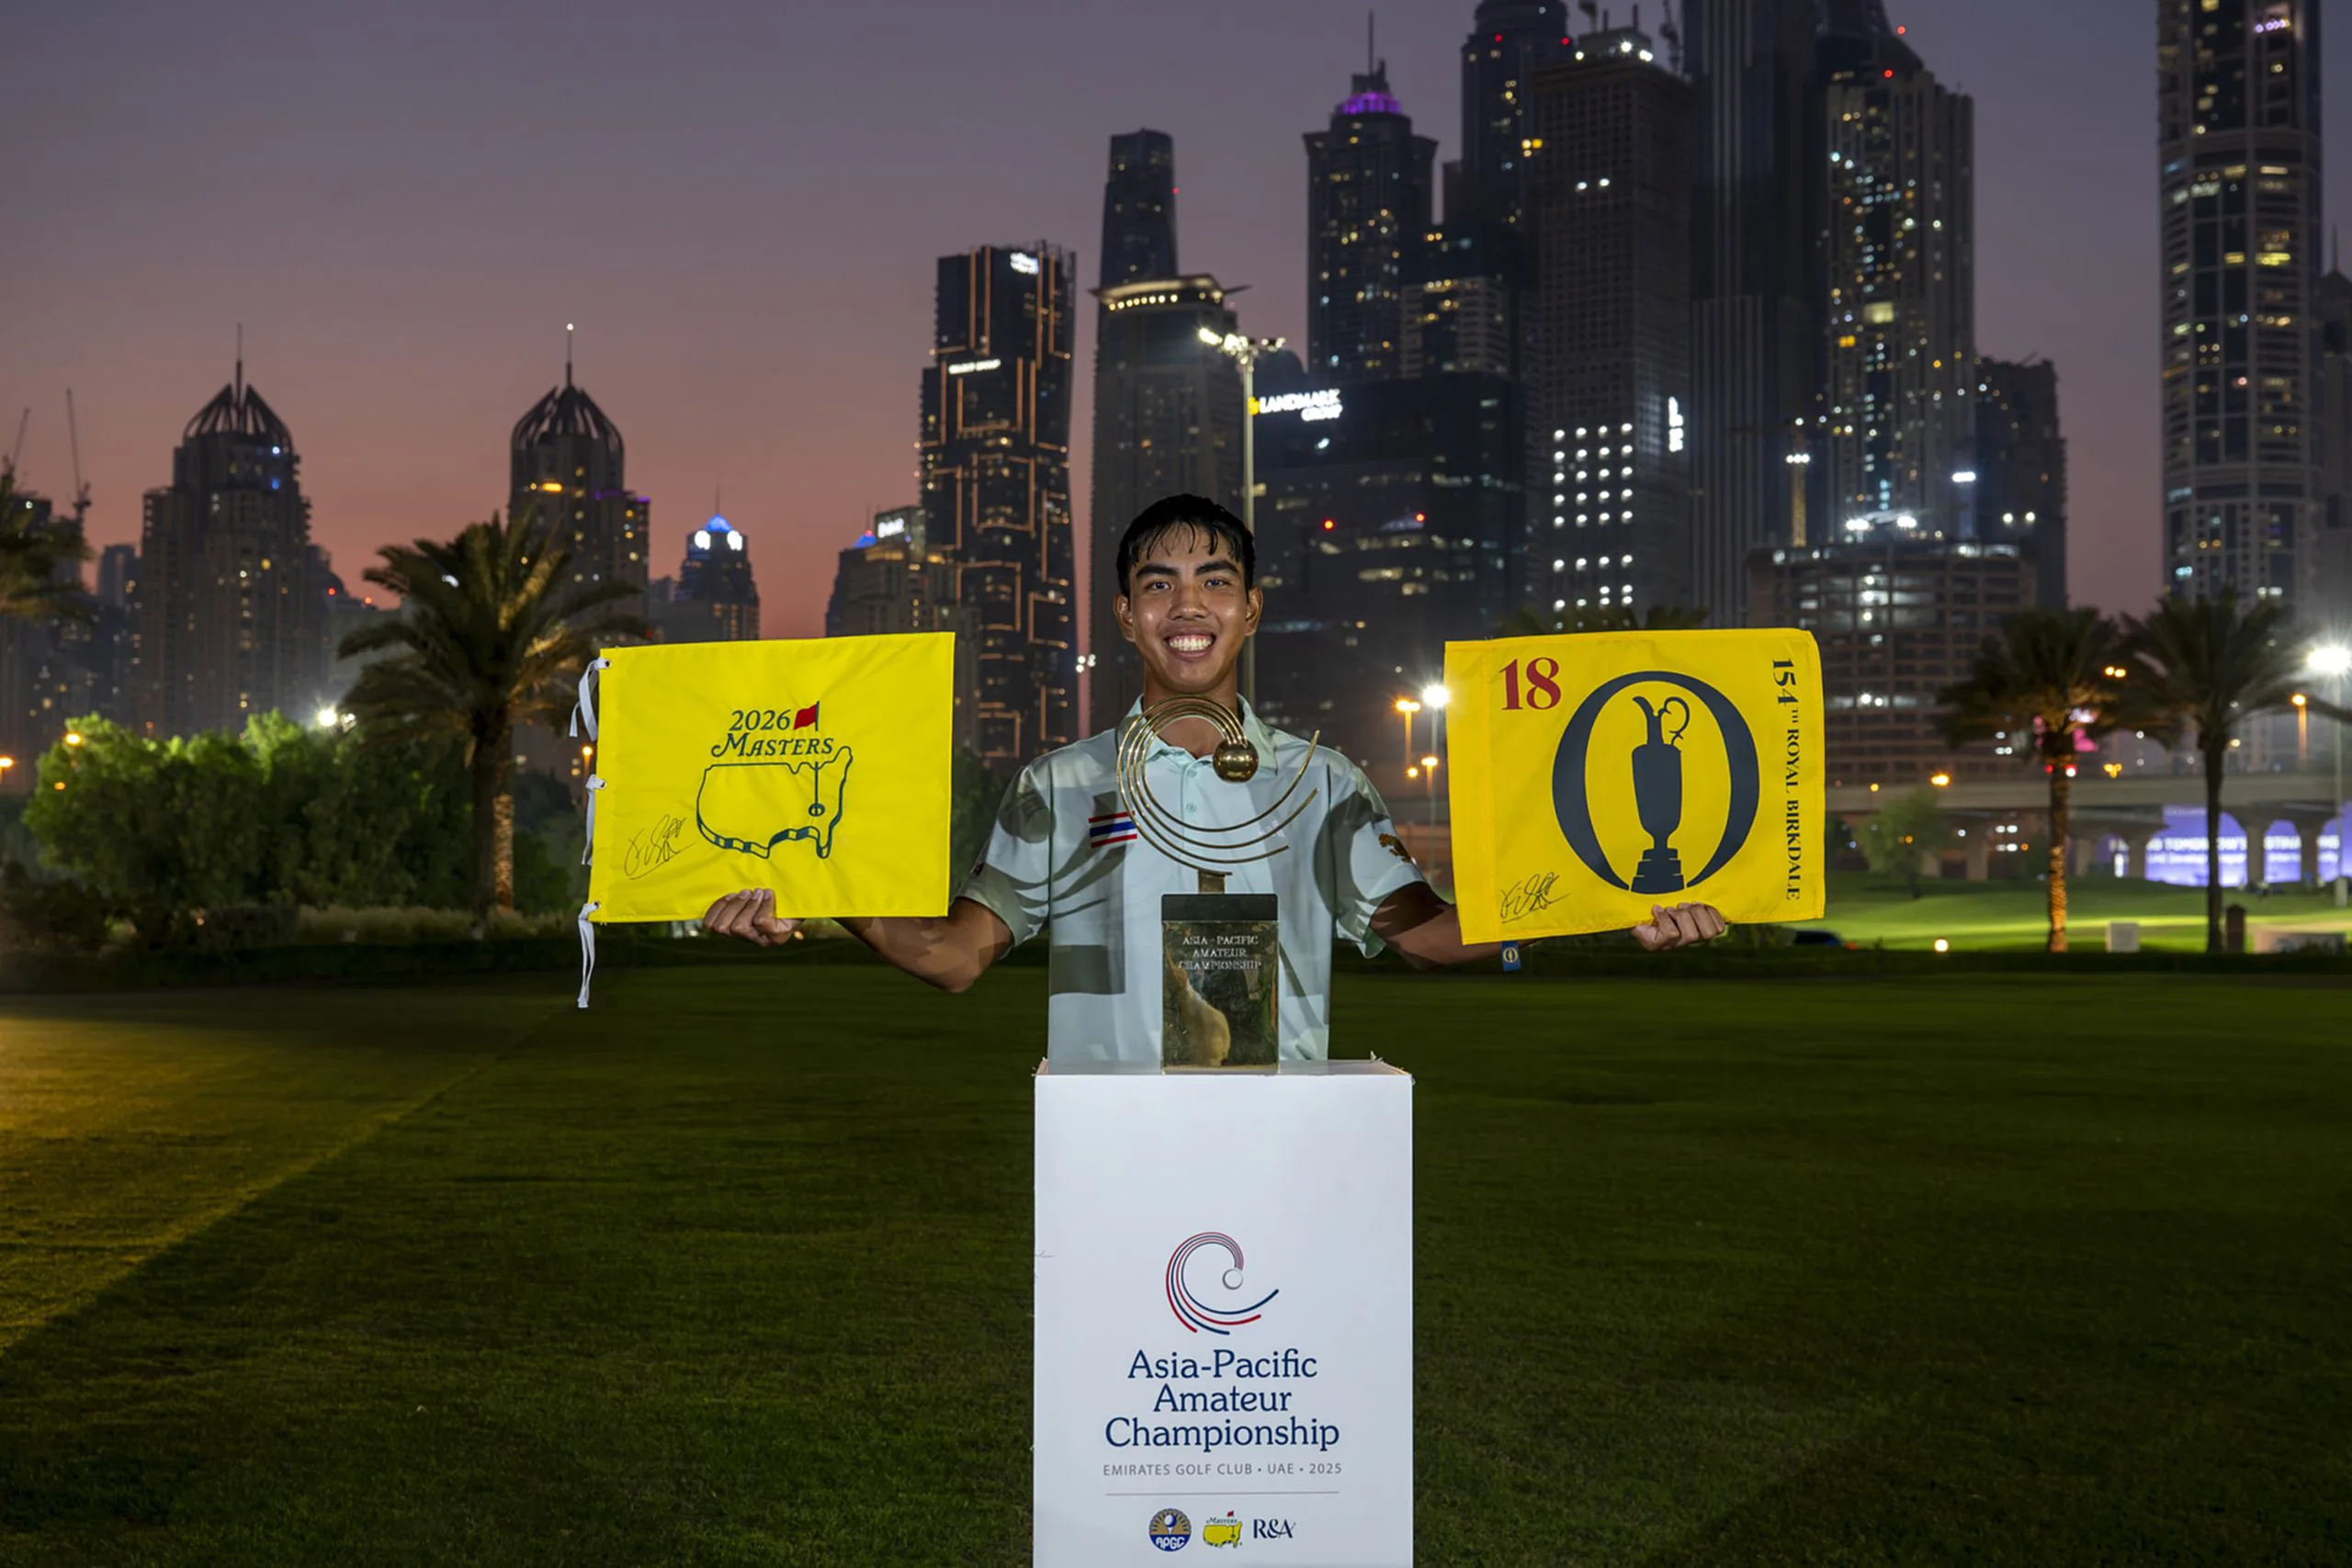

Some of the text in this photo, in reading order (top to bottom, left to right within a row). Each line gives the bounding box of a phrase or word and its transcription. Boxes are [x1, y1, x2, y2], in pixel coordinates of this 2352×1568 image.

[1259, 389, 1340, 414] LANDMARK
[1499, 657, 1561, 710] 18
[729, 709, 792, 731] 2026
[1785, 728, 1801, 793] ROYAL
[1786, 799, 1802, 900] BIRKDALE
[1178, 960, 1262, 970] CHAMPIONSHIP
[1193, 948, 1248, 958] AMATEUR
[1127, 1348, 1317, 1379] Asia-Pacific
[1153, 1382, 1293, 1412] Amateur
[1104, 1416, 1340, 1453] Championship
[1102, 1462, 1342, 1477] EMIRATES GOLF CLUB UAE 2025
[1253, 1518, 1296, 1540] R&A
[1155, 1536, 1186, 1551] APGC
